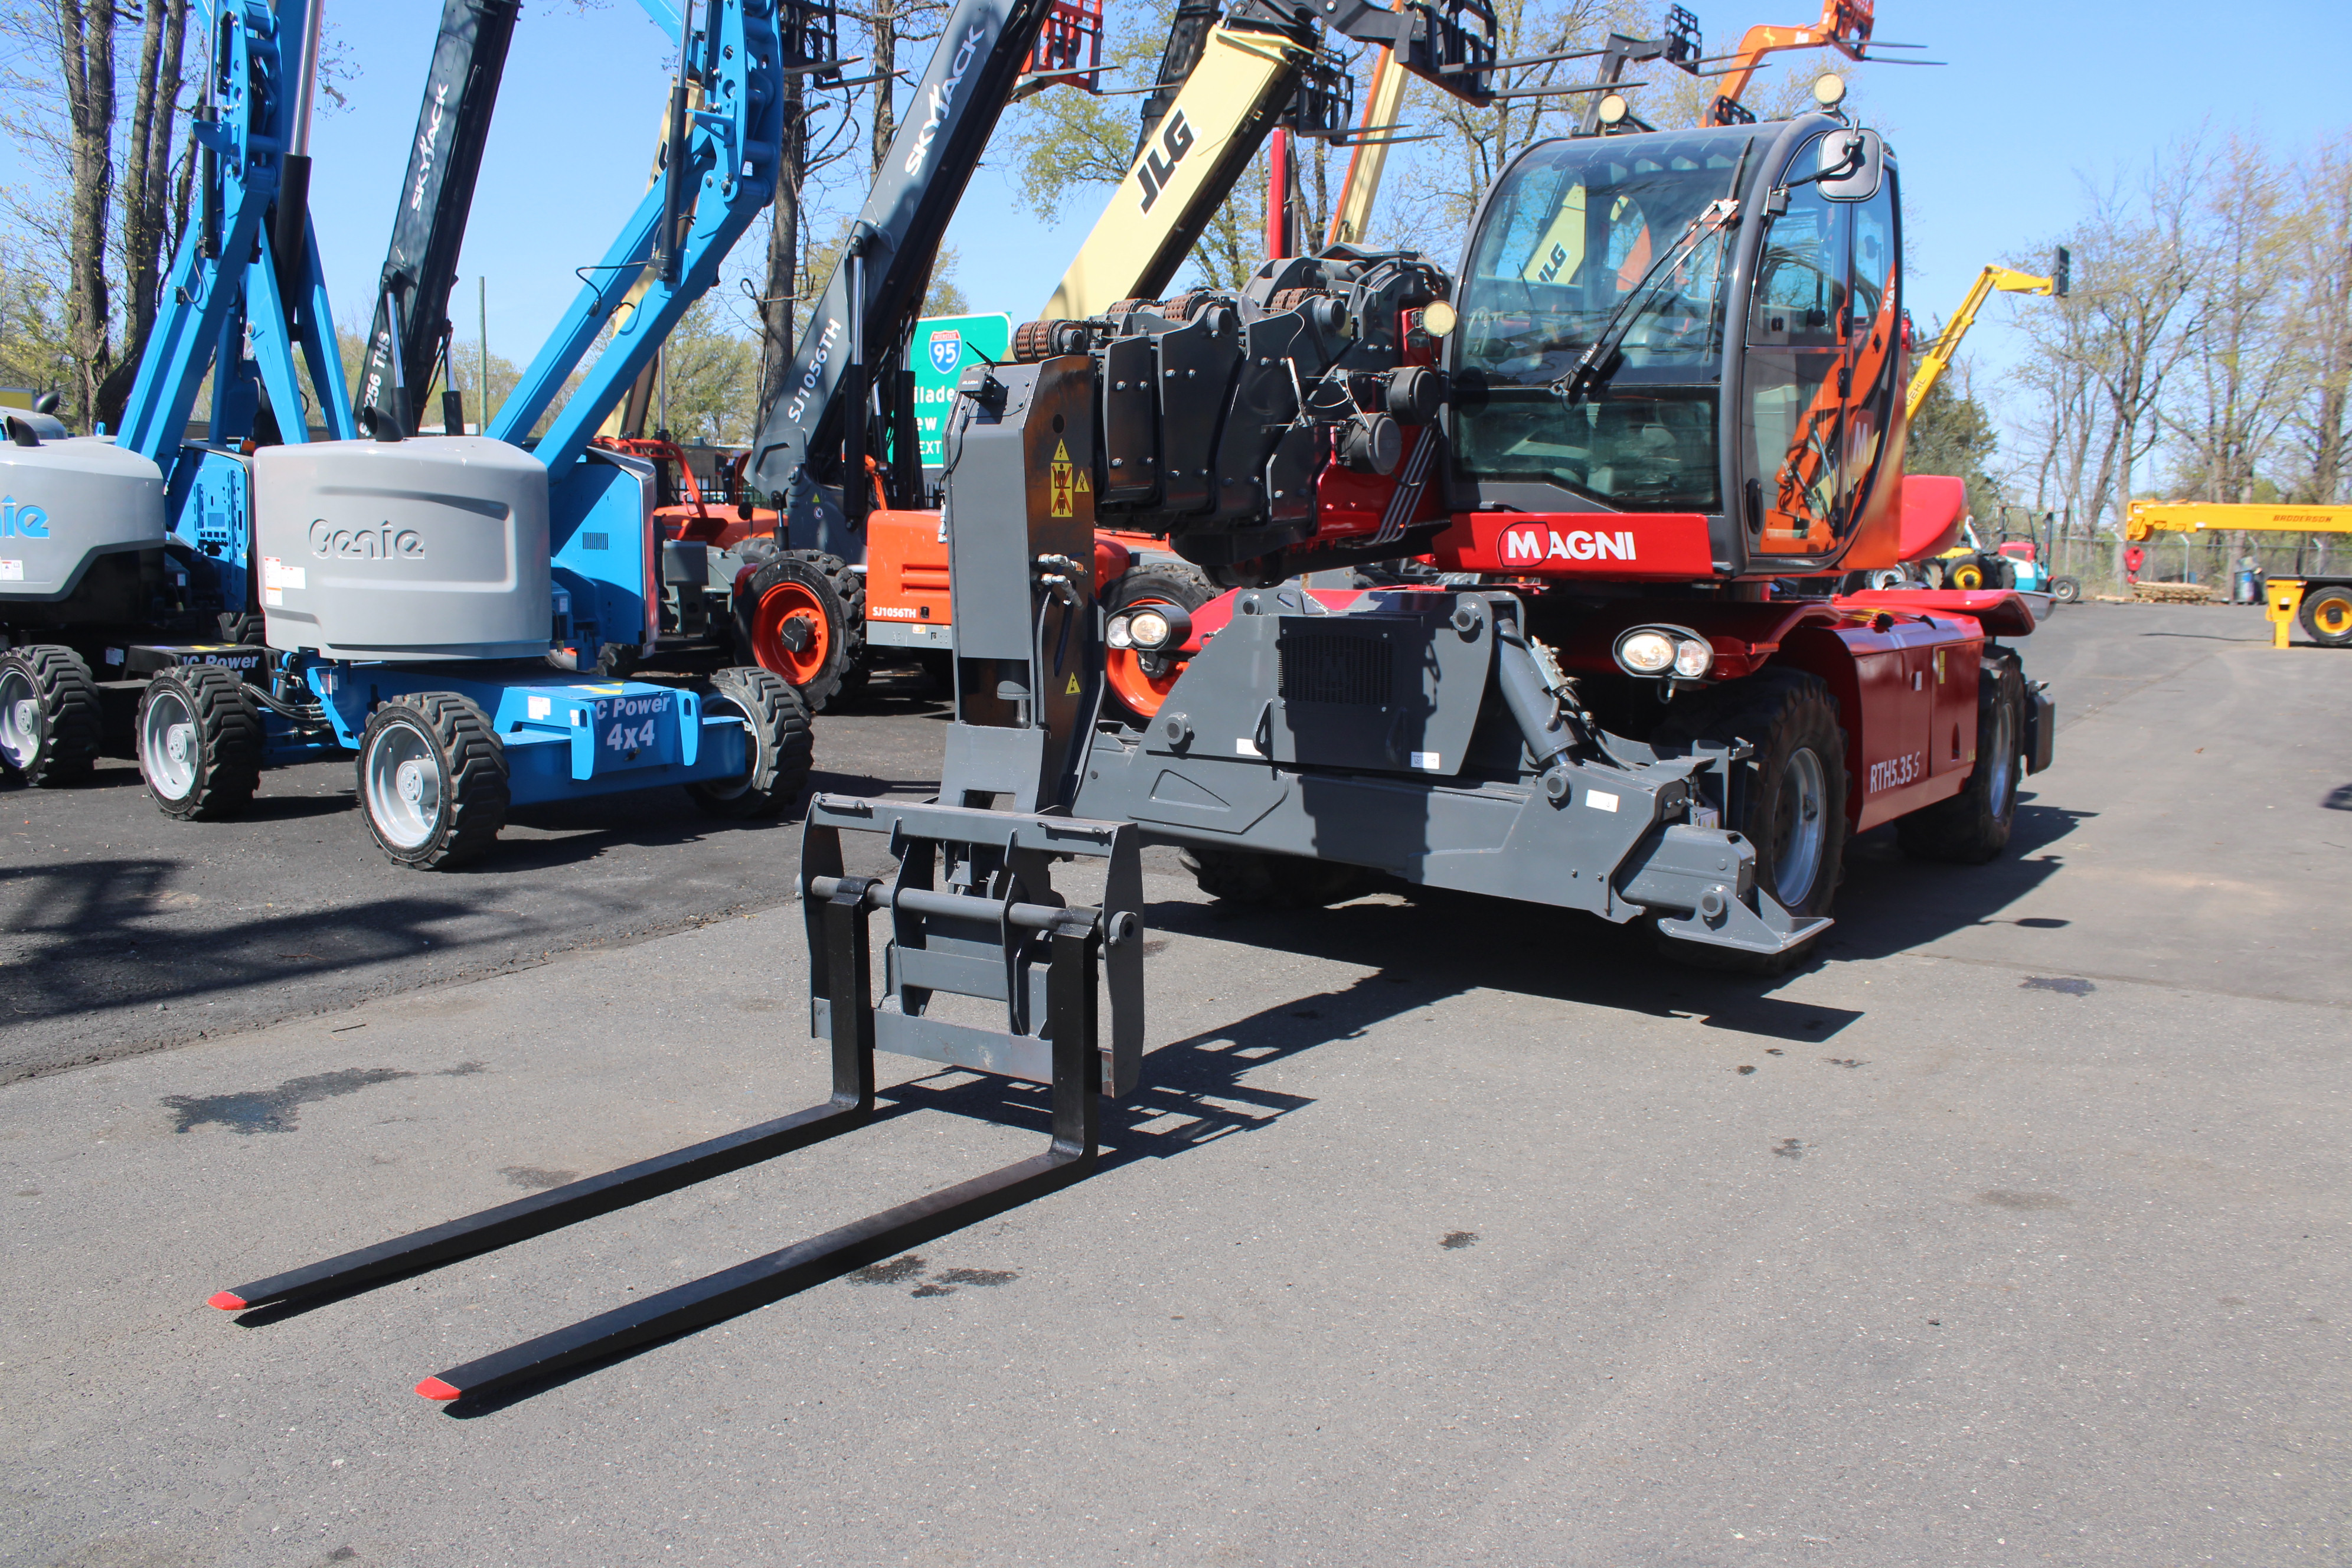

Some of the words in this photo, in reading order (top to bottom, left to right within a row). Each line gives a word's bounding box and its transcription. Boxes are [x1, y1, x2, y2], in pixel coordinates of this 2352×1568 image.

[905, 25, 985, 177] SKYJACK
[412, 83, 449, 211] SKYJACK
[1136, 107, 1194, 215] JLG
[788, 318, 842, 424] SJ1056TH
[934, 343, 956, 364] 95
[358, 373, 382, 437] S256
[372, 331, 391, 369] THS
[919, 440, 942, 455] EXT
[0, 495, 50, 539] ie
[309, 518, 425, 560] Genie
[1508, 530, 1636, 560] MAGNI
[872, 606, 917, 619] SJ1056TH
[205, 655, 259, 669] Power
[613, 697, 671, 718] Power
[607, 719, 655, 751] 4x4
[1870, 754, 1912, 794] RTH5.35
